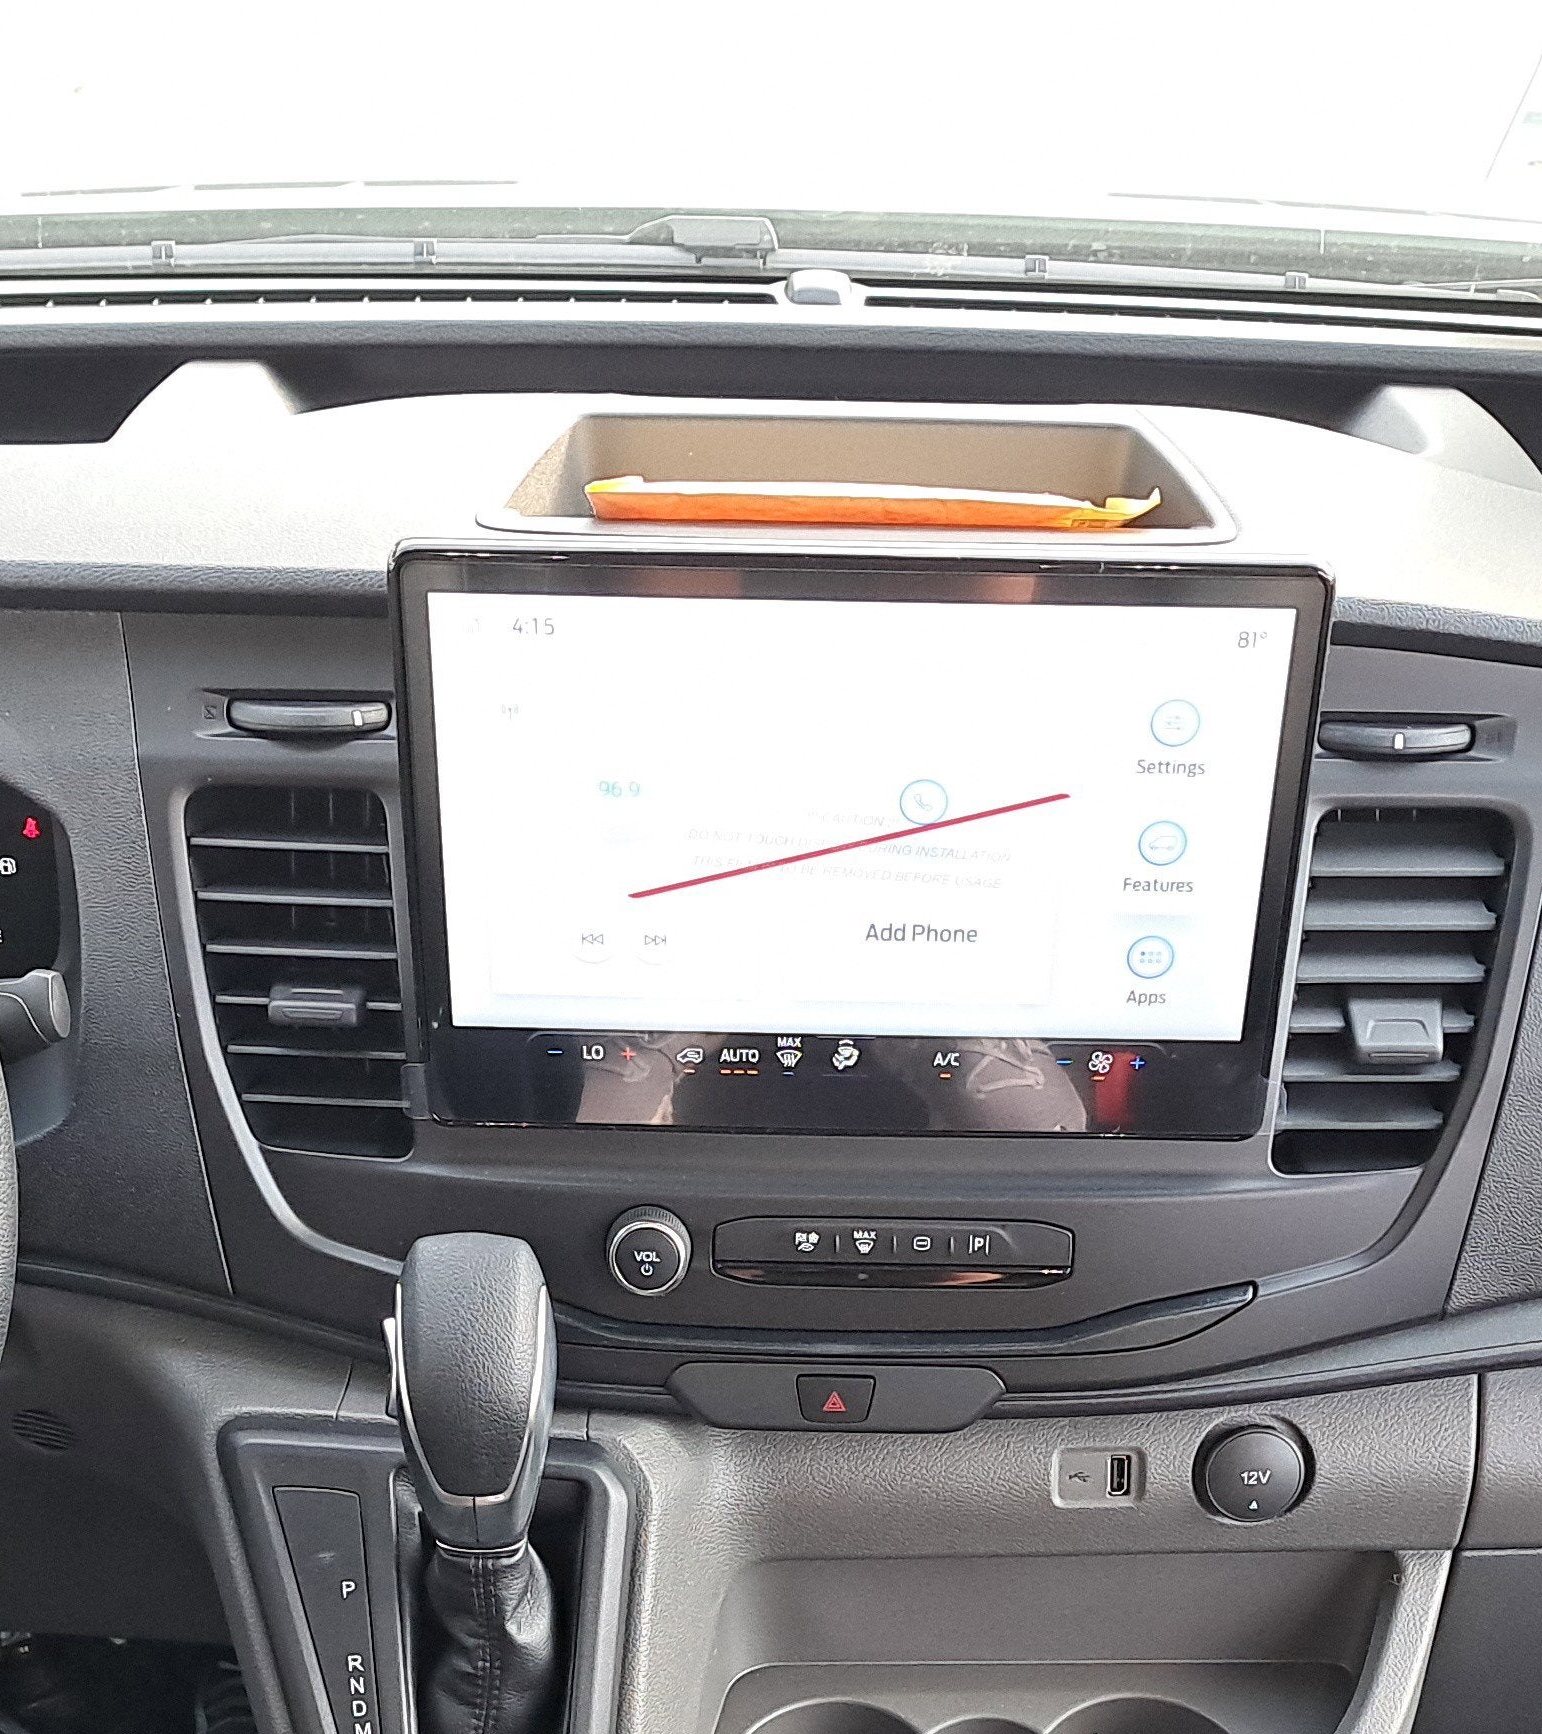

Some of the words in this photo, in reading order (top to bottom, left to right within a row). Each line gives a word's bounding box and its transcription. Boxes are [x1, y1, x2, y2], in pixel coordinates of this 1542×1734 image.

[512, 617, 556, 636] 4:15
[1237, 630, 1268, 650] 81°
[1136, 759, 1206, 778] Settings
[1123, 876, 1194, 894] Features
[865, 923, 908, 943] Add
[912, 924, 978, 944] Phone
[1126, 989, 1167, 1006] Apps
[777, 1036, 802, 1048] MAX
[582, 1045, 604, 1061] LO
[719, 1048, 759, 1063] AUTO
[933, 1051, 960, 1068] A/C
[853, 1229, 877, 1240] MAX
[633, 1249, 661, 1262] VOL
[1240, 1469, 1272, 1486] 12V
[341, 1580, 356, 1599] P
[347, 1654, 365, 1673] R
[349, 1676, 365, 1695] N
[352, 1699, 367, 1718] D
